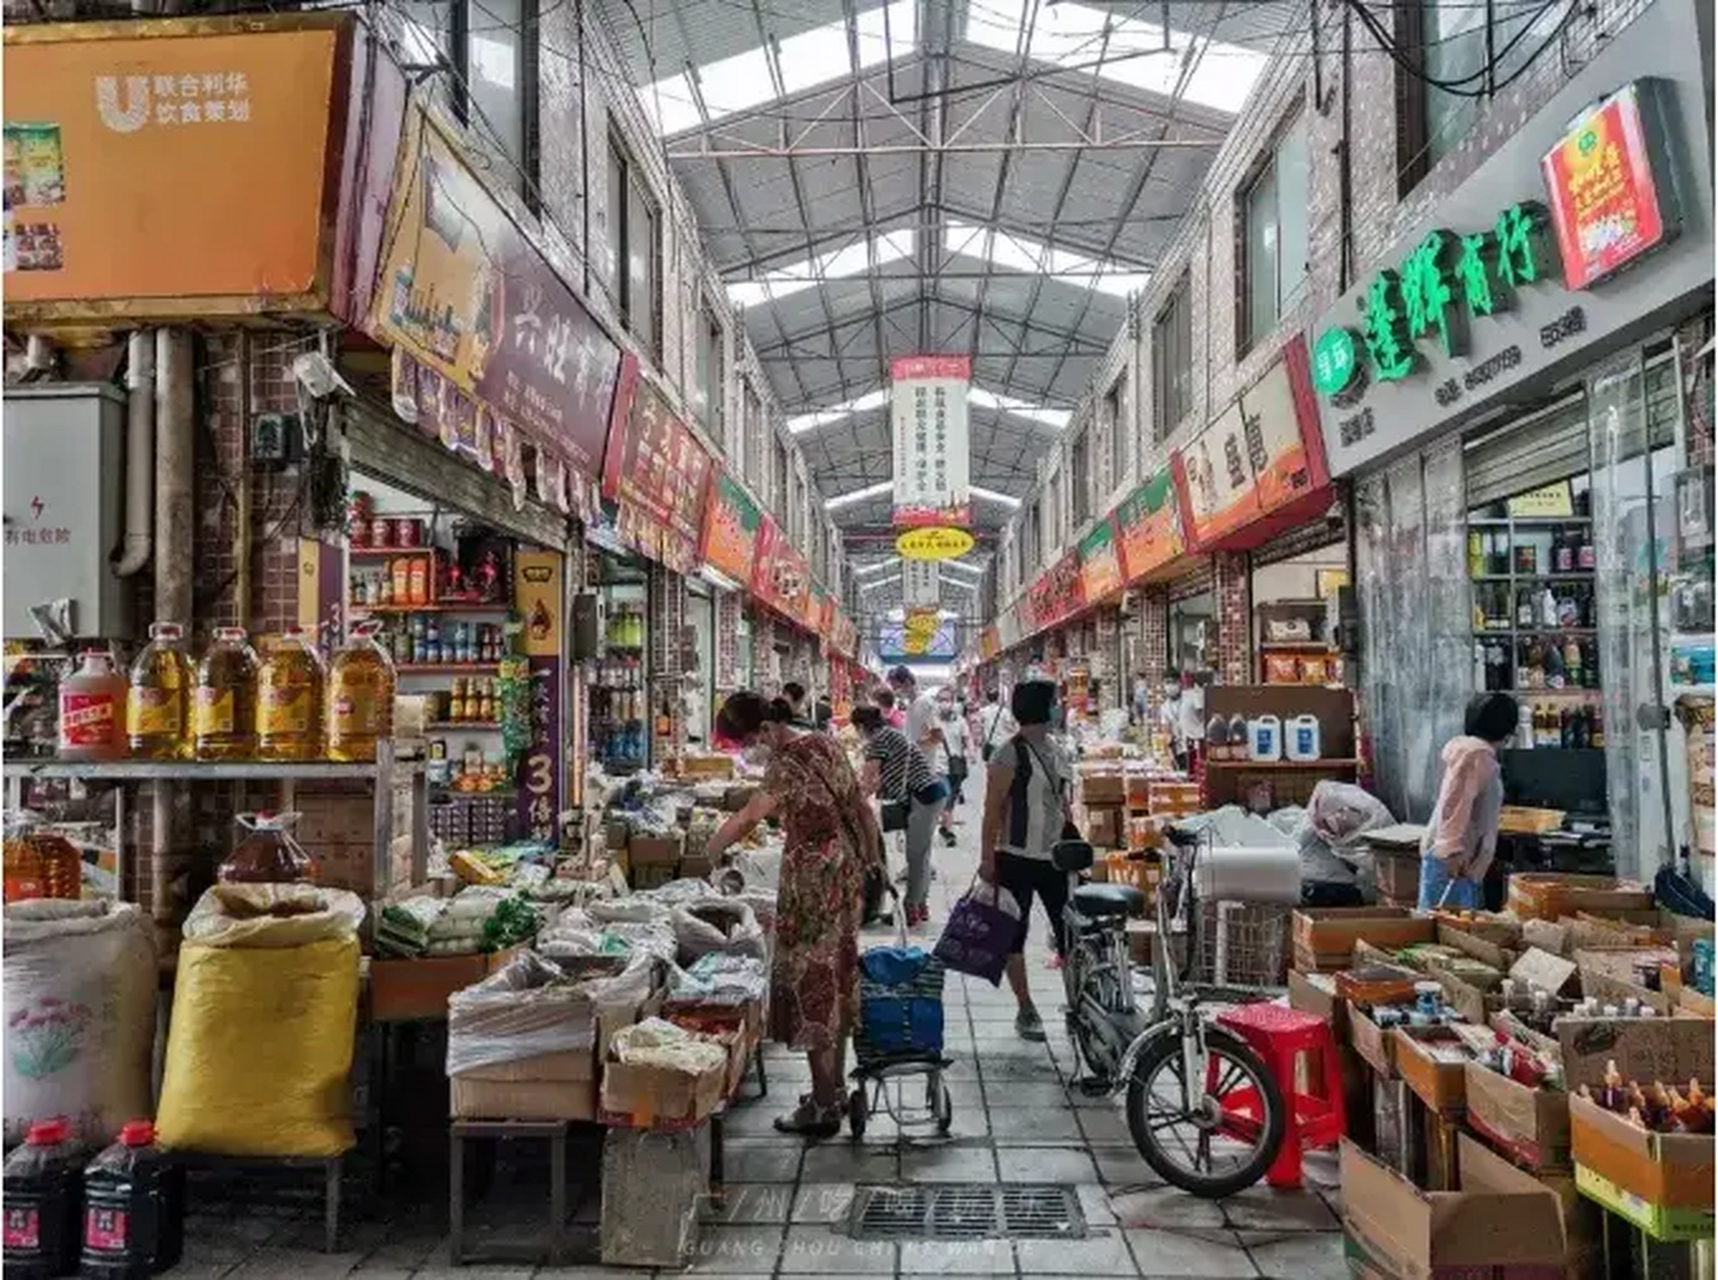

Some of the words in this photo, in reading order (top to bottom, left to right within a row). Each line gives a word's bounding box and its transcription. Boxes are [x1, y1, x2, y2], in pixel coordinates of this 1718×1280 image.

[153, 73, 247, 97] 联合利华
[156, 99, 250, 125] 饮食策划
[4, 527, 71, 545] 有电危险
